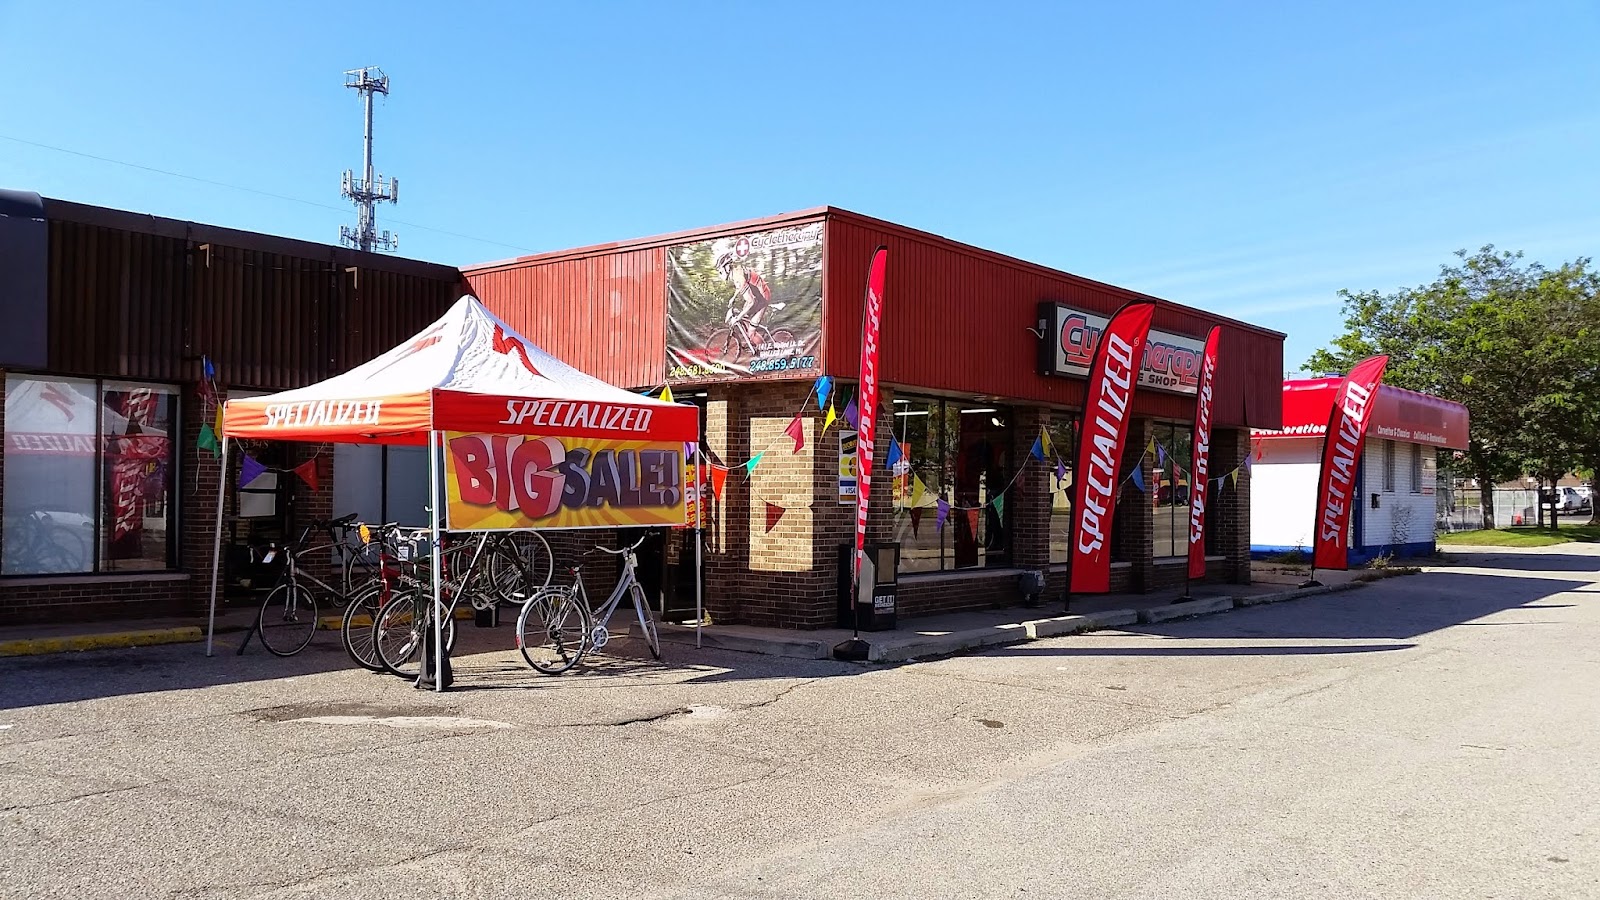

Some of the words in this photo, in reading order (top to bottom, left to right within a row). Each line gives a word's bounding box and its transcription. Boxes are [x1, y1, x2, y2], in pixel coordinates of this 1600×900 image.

[749, 356, 814, 372] 248.859.5177
[1060, 313, 1200, 388] Cyherap
[1148, 374, 1178, 387] SHOP
[262, 400, 383, 428] SPECIALIZED
[499, 400, 653, 432] SPECIALIZED
[1078, 332, 1133, 563] SPECIALIZED
[449, 433, 566, 519] BIG
[559, 447, 680, 508] SALE!
[1322, 380, 1371, 548] SPECIALIZED
[875, 595, 887, 604] GET
